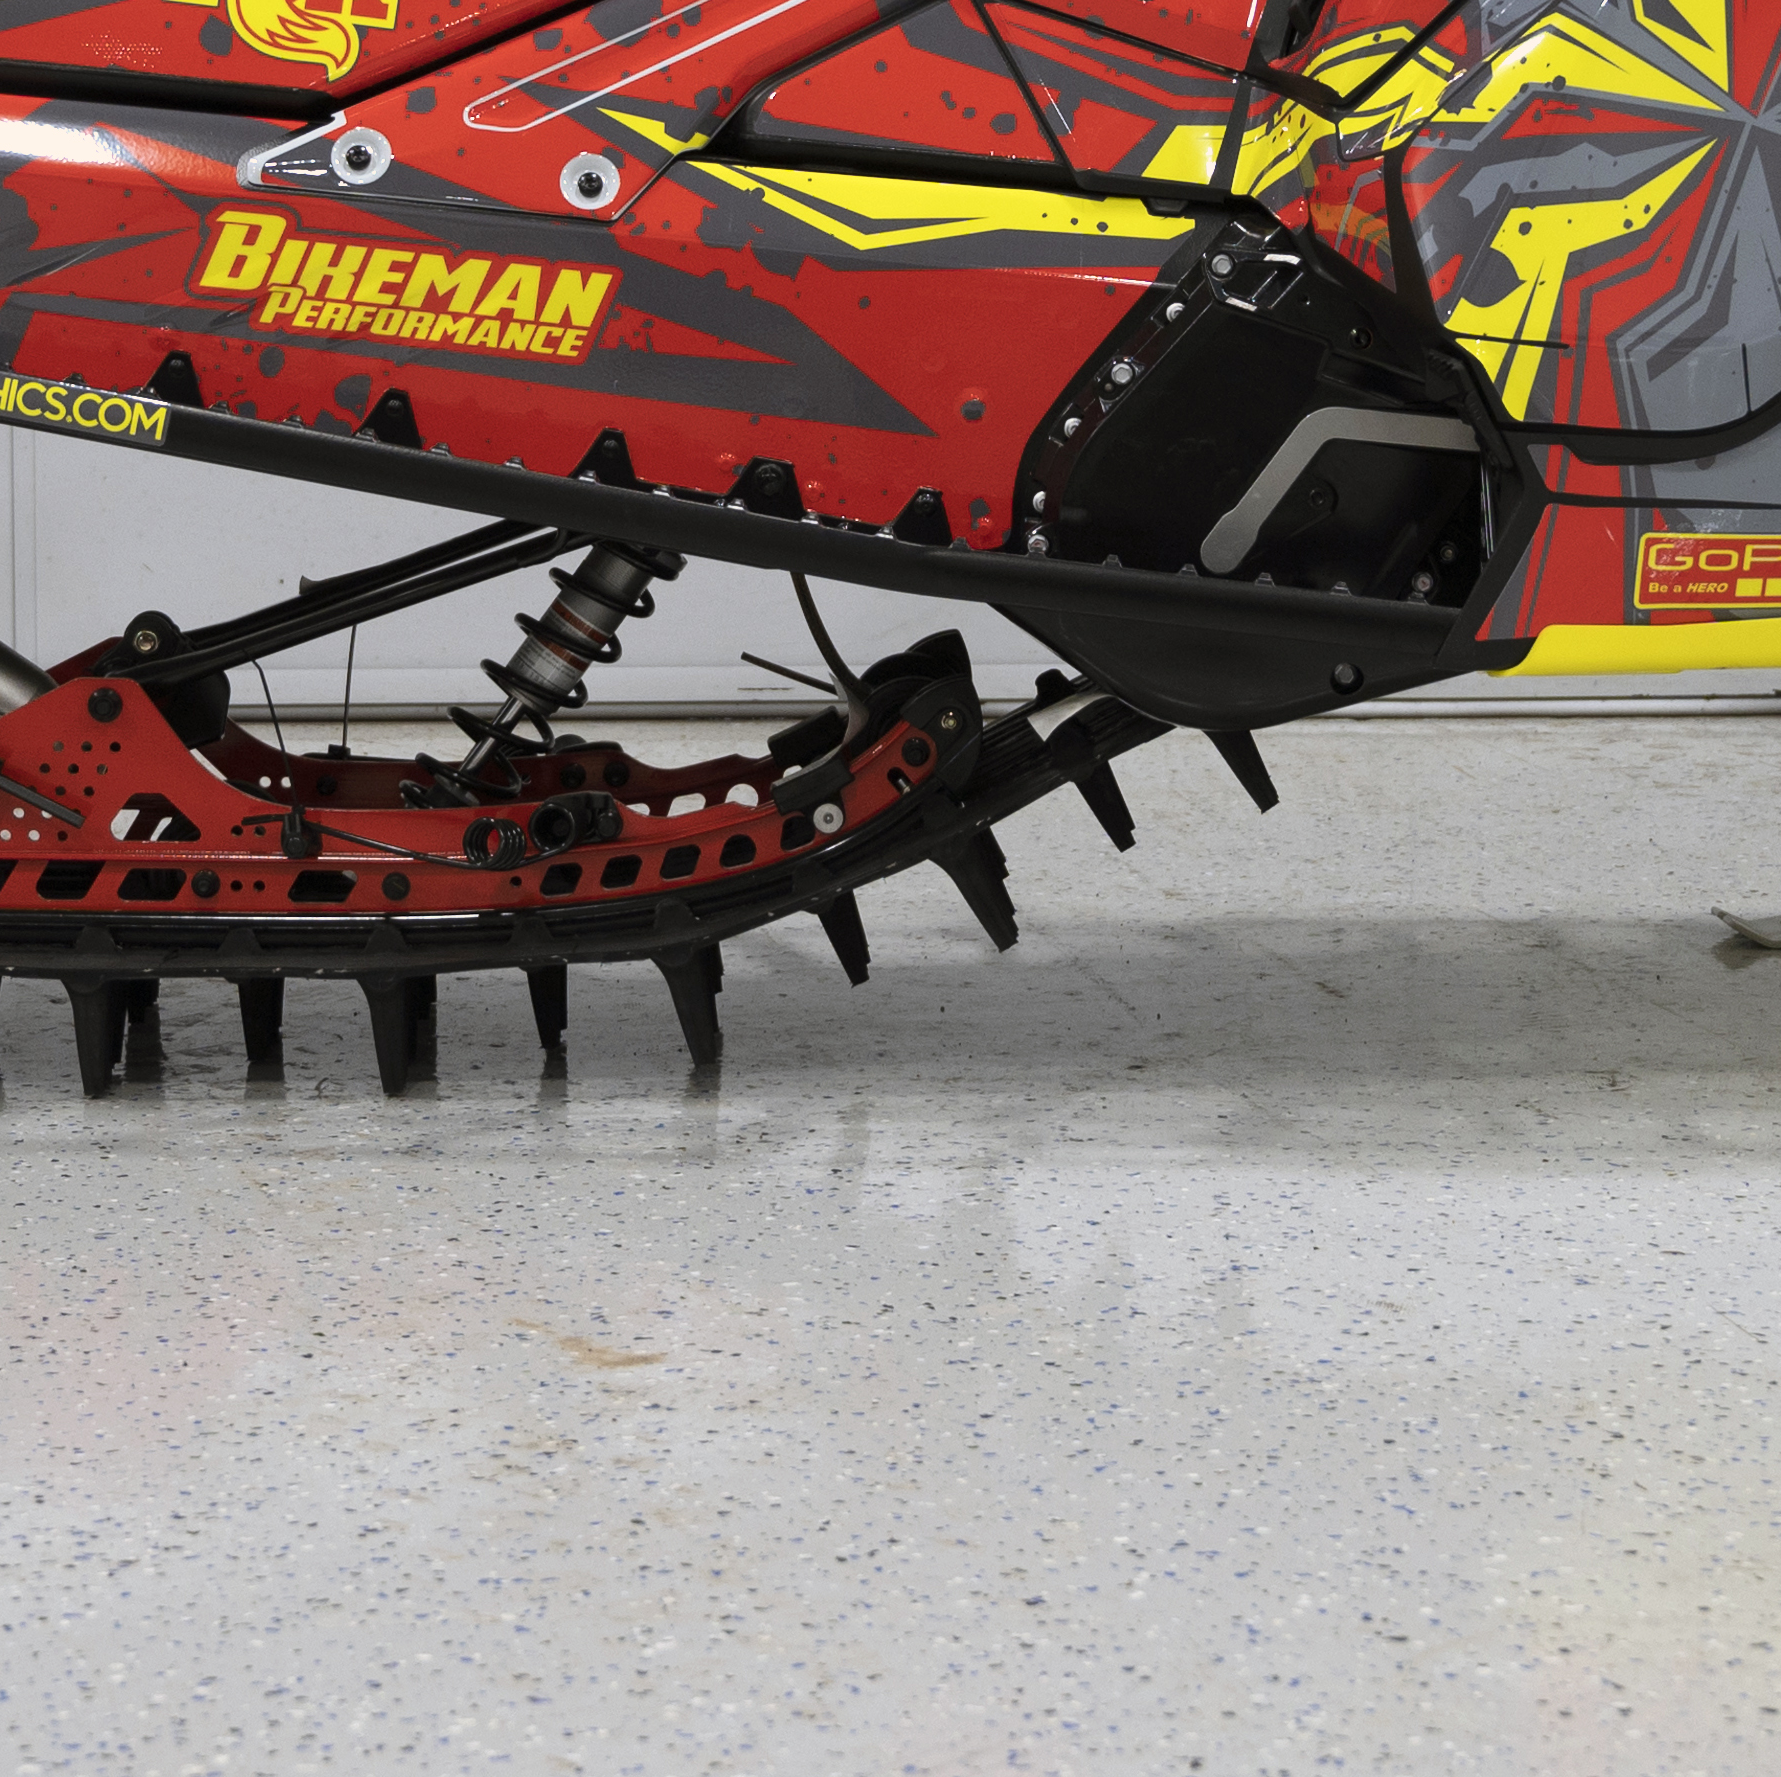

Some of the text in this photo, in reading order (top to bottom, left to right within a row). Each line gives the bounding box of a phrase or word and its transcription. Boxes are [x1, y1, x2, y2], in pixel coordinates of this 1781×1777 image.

[198, 209, 614, 328] BIKEMAN
[258, 285, 589, 358] PERFORMANCE
[1648, 582, 1729, 593] Be a HERO
